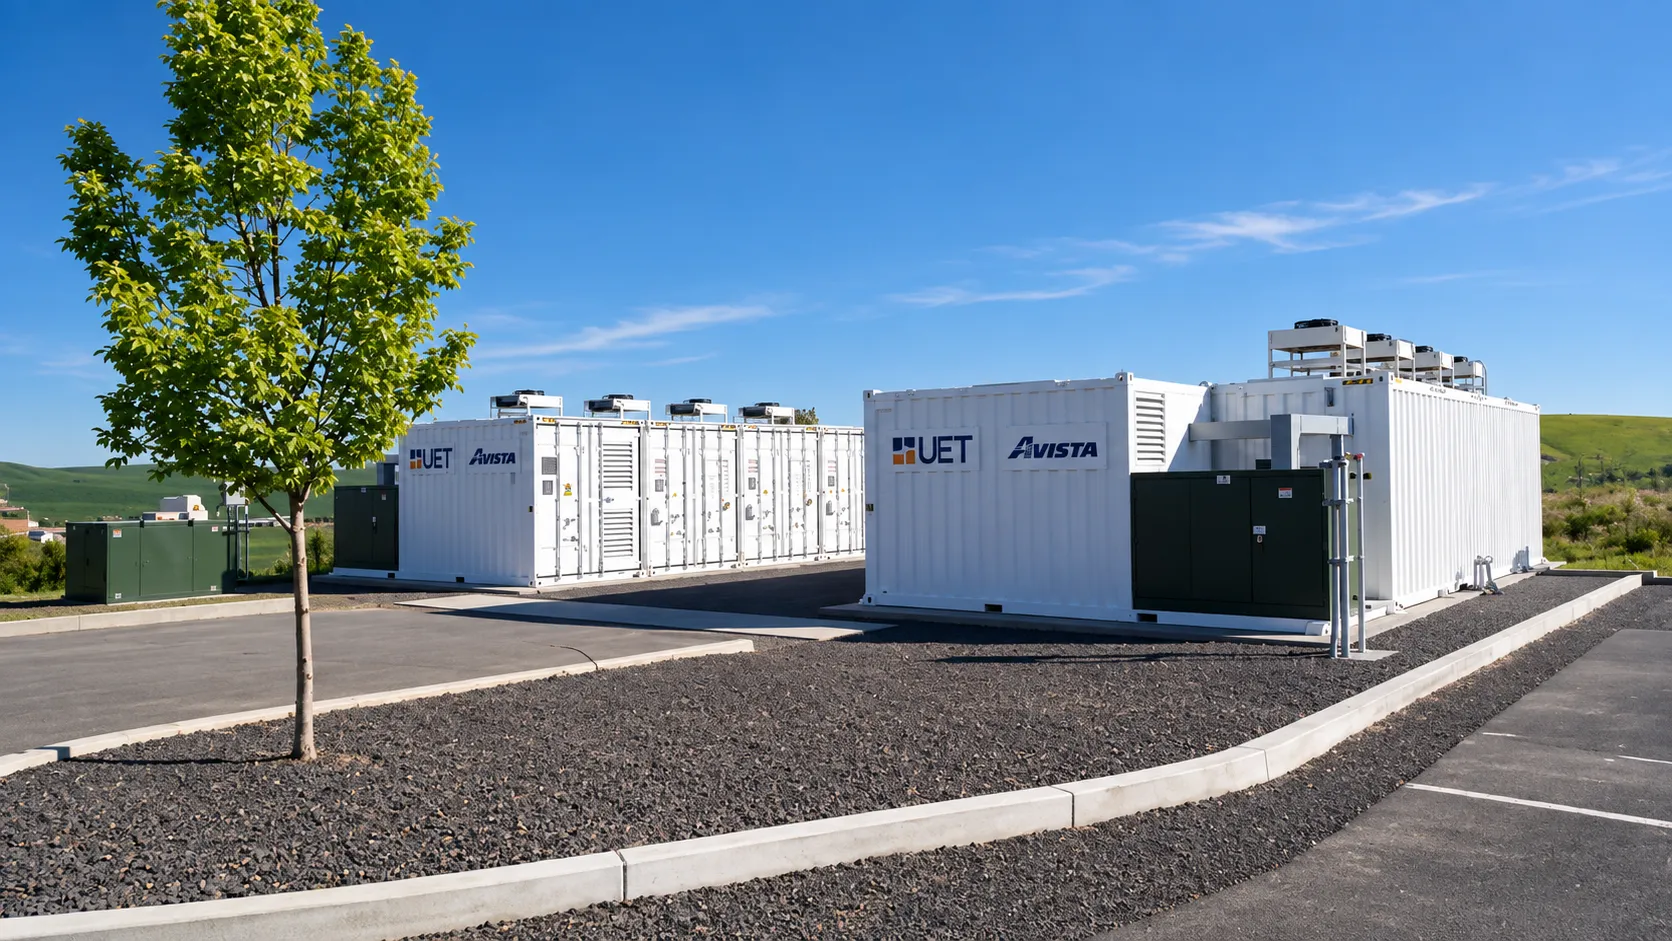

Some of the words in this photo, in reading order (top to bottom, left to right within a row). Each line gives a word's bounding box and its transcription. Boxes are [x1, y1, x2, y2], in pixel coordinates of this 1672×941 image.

[422, 447, 453, 469] UET
[469, 448, 516, 466] AVISTA
[918, 435, 973, 464] UET
[1008, 436, 1098, 459] AVISTA
